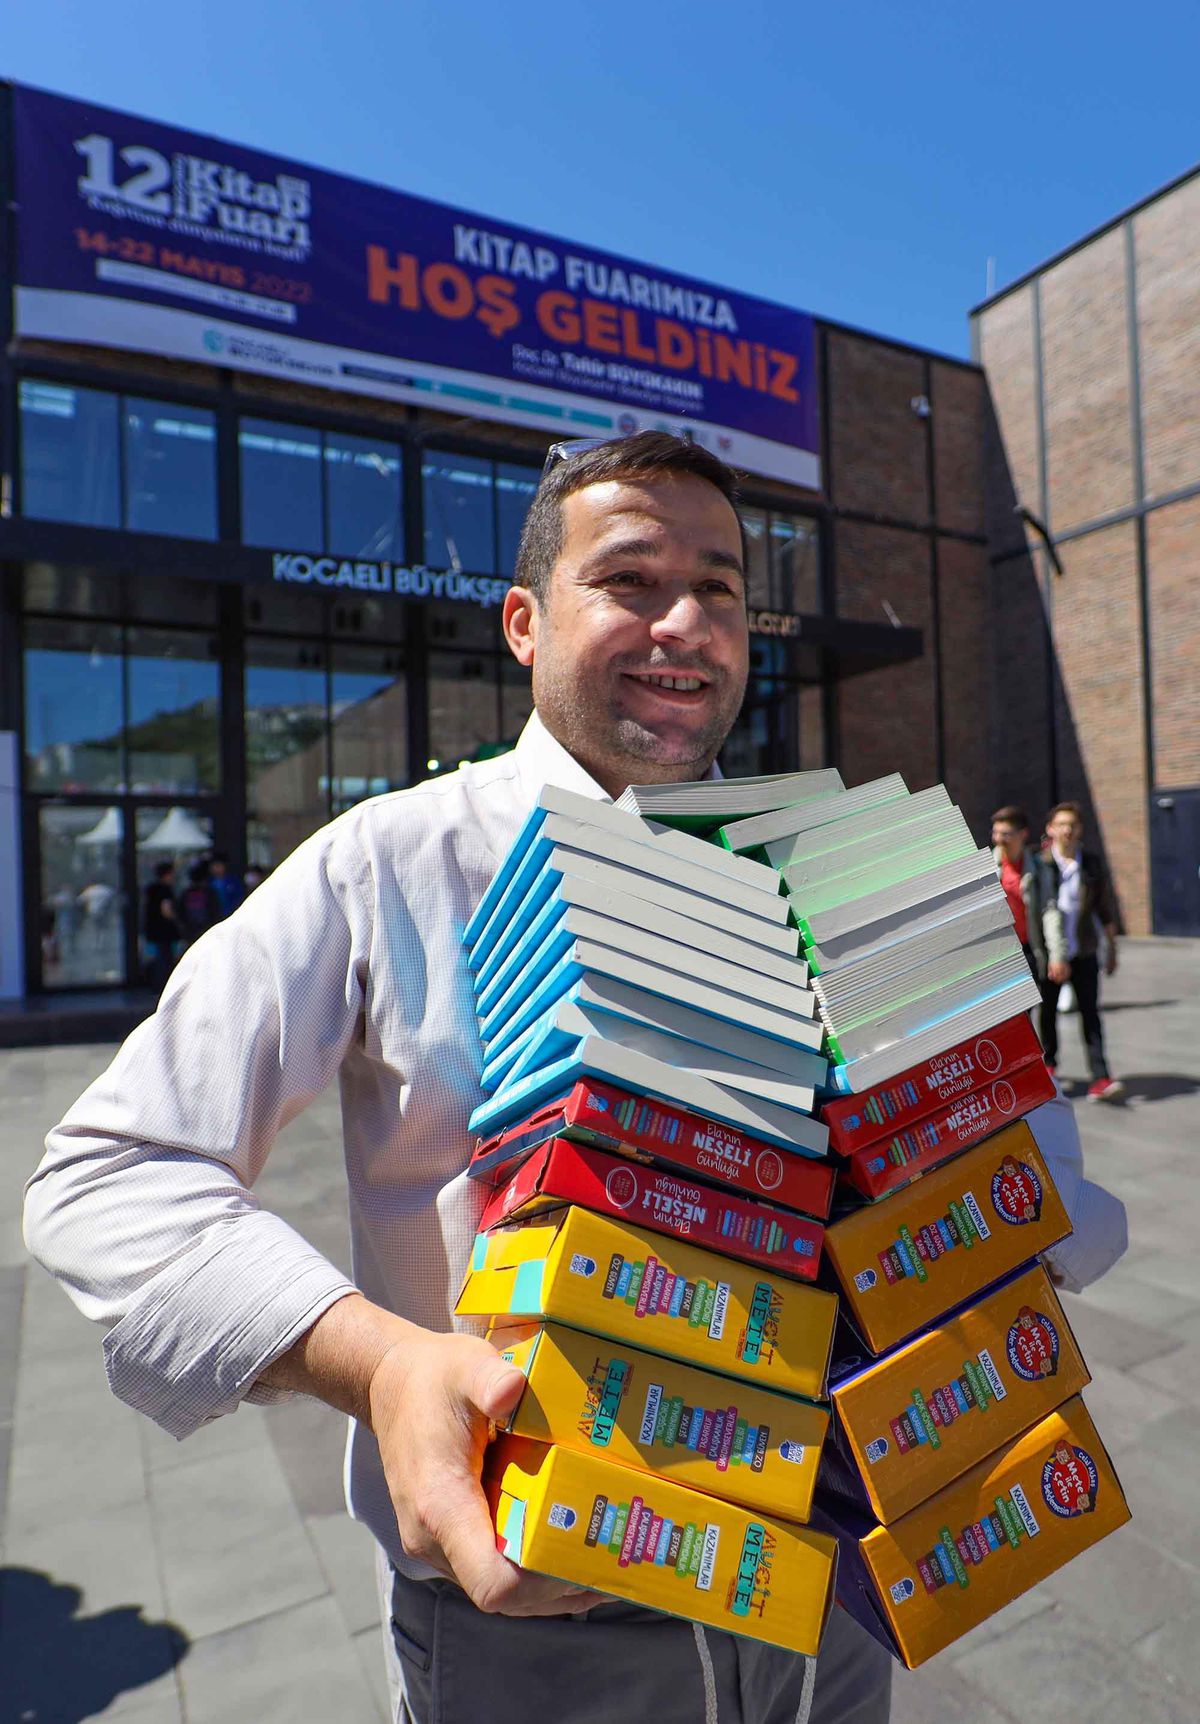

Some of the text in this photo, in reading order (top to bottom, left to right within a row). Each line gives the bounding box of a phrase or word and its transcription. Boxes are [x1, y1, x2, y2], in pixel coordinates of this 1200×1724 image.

[73, 133, 171, 215] 12
[453, 224, 738, 333] KİTAP FUARIMIZA
[365, 244, 521, 339] HOŞ
[536, 291, 799, 404] GELDİNİZ
[273, 553, 392, 593] KOCAELİ
[925, 1054, 975, 1090] NEŞELİ
[946, 1095, 991, 1130] NEŞELİ
[693, 1131, 751, 1166] NEŞELİ
[696, 1153, 739, 1179] Günlüğü
[642, 1189, 706, 1224] NEŞELİ
[1002, 1183, 1017, 1211] Çetin
[1014, 1175, 1030, 1204] Mete
[964, 1194, 988, 1236] KAZANIMLAR
[660, 1276, 674, 1308] TASARRUF
[680, 1287, 693, 1311] ŞEFKAT
[709, 1285, 730, 1335] KAZANIMLAR
[742, 1286, 771, 1355] METE
[1018, 1336, 1034, 1367] Çetin
[1031, 1327, 1046, 1357] Mete
[979, 1353, 1004, 1396] KAZANIMLAR
[592, 1367, 624, 1442] METE
[640, 1387, 660, 1441] KAZANIMLAR
[678, 1413, 691, 1438] ŞEFKAT
[698, 1415, 713, 1449] TASARRUF
[1054, 1472, 1069, 1503] Çetin
[1067, 1462, 1083, 1493] Mete
[1012, 1488, 1037, 1533] KAZANIMLAR
[645, 1519, 661, 1556] TASARRUF
[667, 1531, 681, 1558] ŞEFKAT
[696, 1528, 720, 1586] KAZANIMLAR
[732, 1527, 764, 1607] METE
